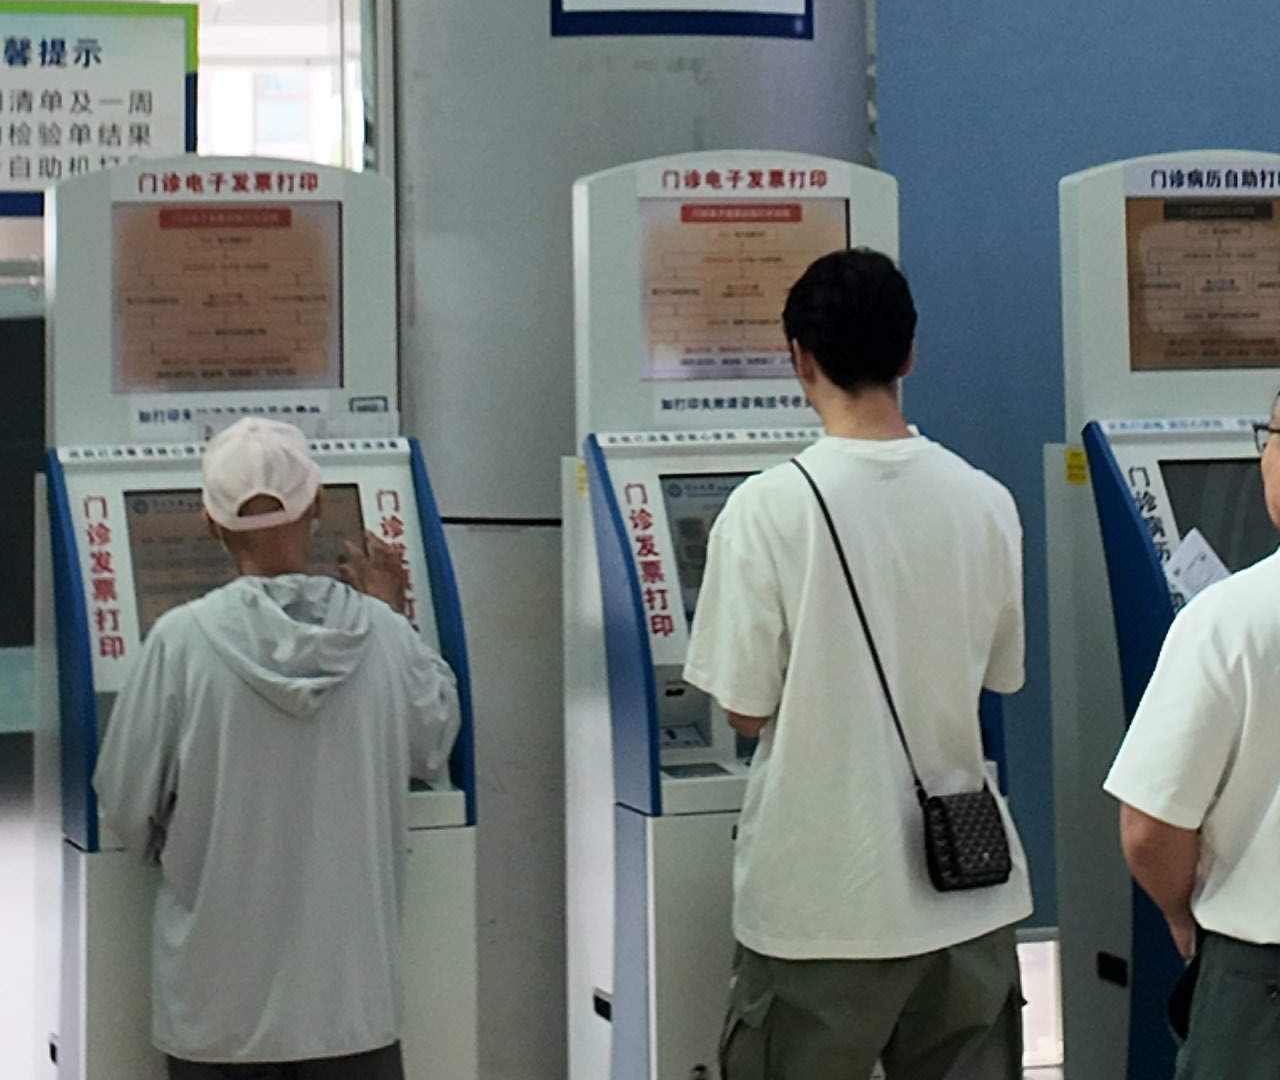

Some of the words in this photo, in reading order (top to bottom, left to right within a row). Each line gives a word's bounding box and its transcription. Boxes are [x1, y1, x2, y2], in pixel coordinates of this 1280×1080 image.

[138, 171, 319, 195] 门诊电子发票打印
[662, 169, 828, 190] 门诊电子发票打印
[84, 495, 125, 660] 门诊发票打印
[624, 483, 674, 637] 门诊发票打印
